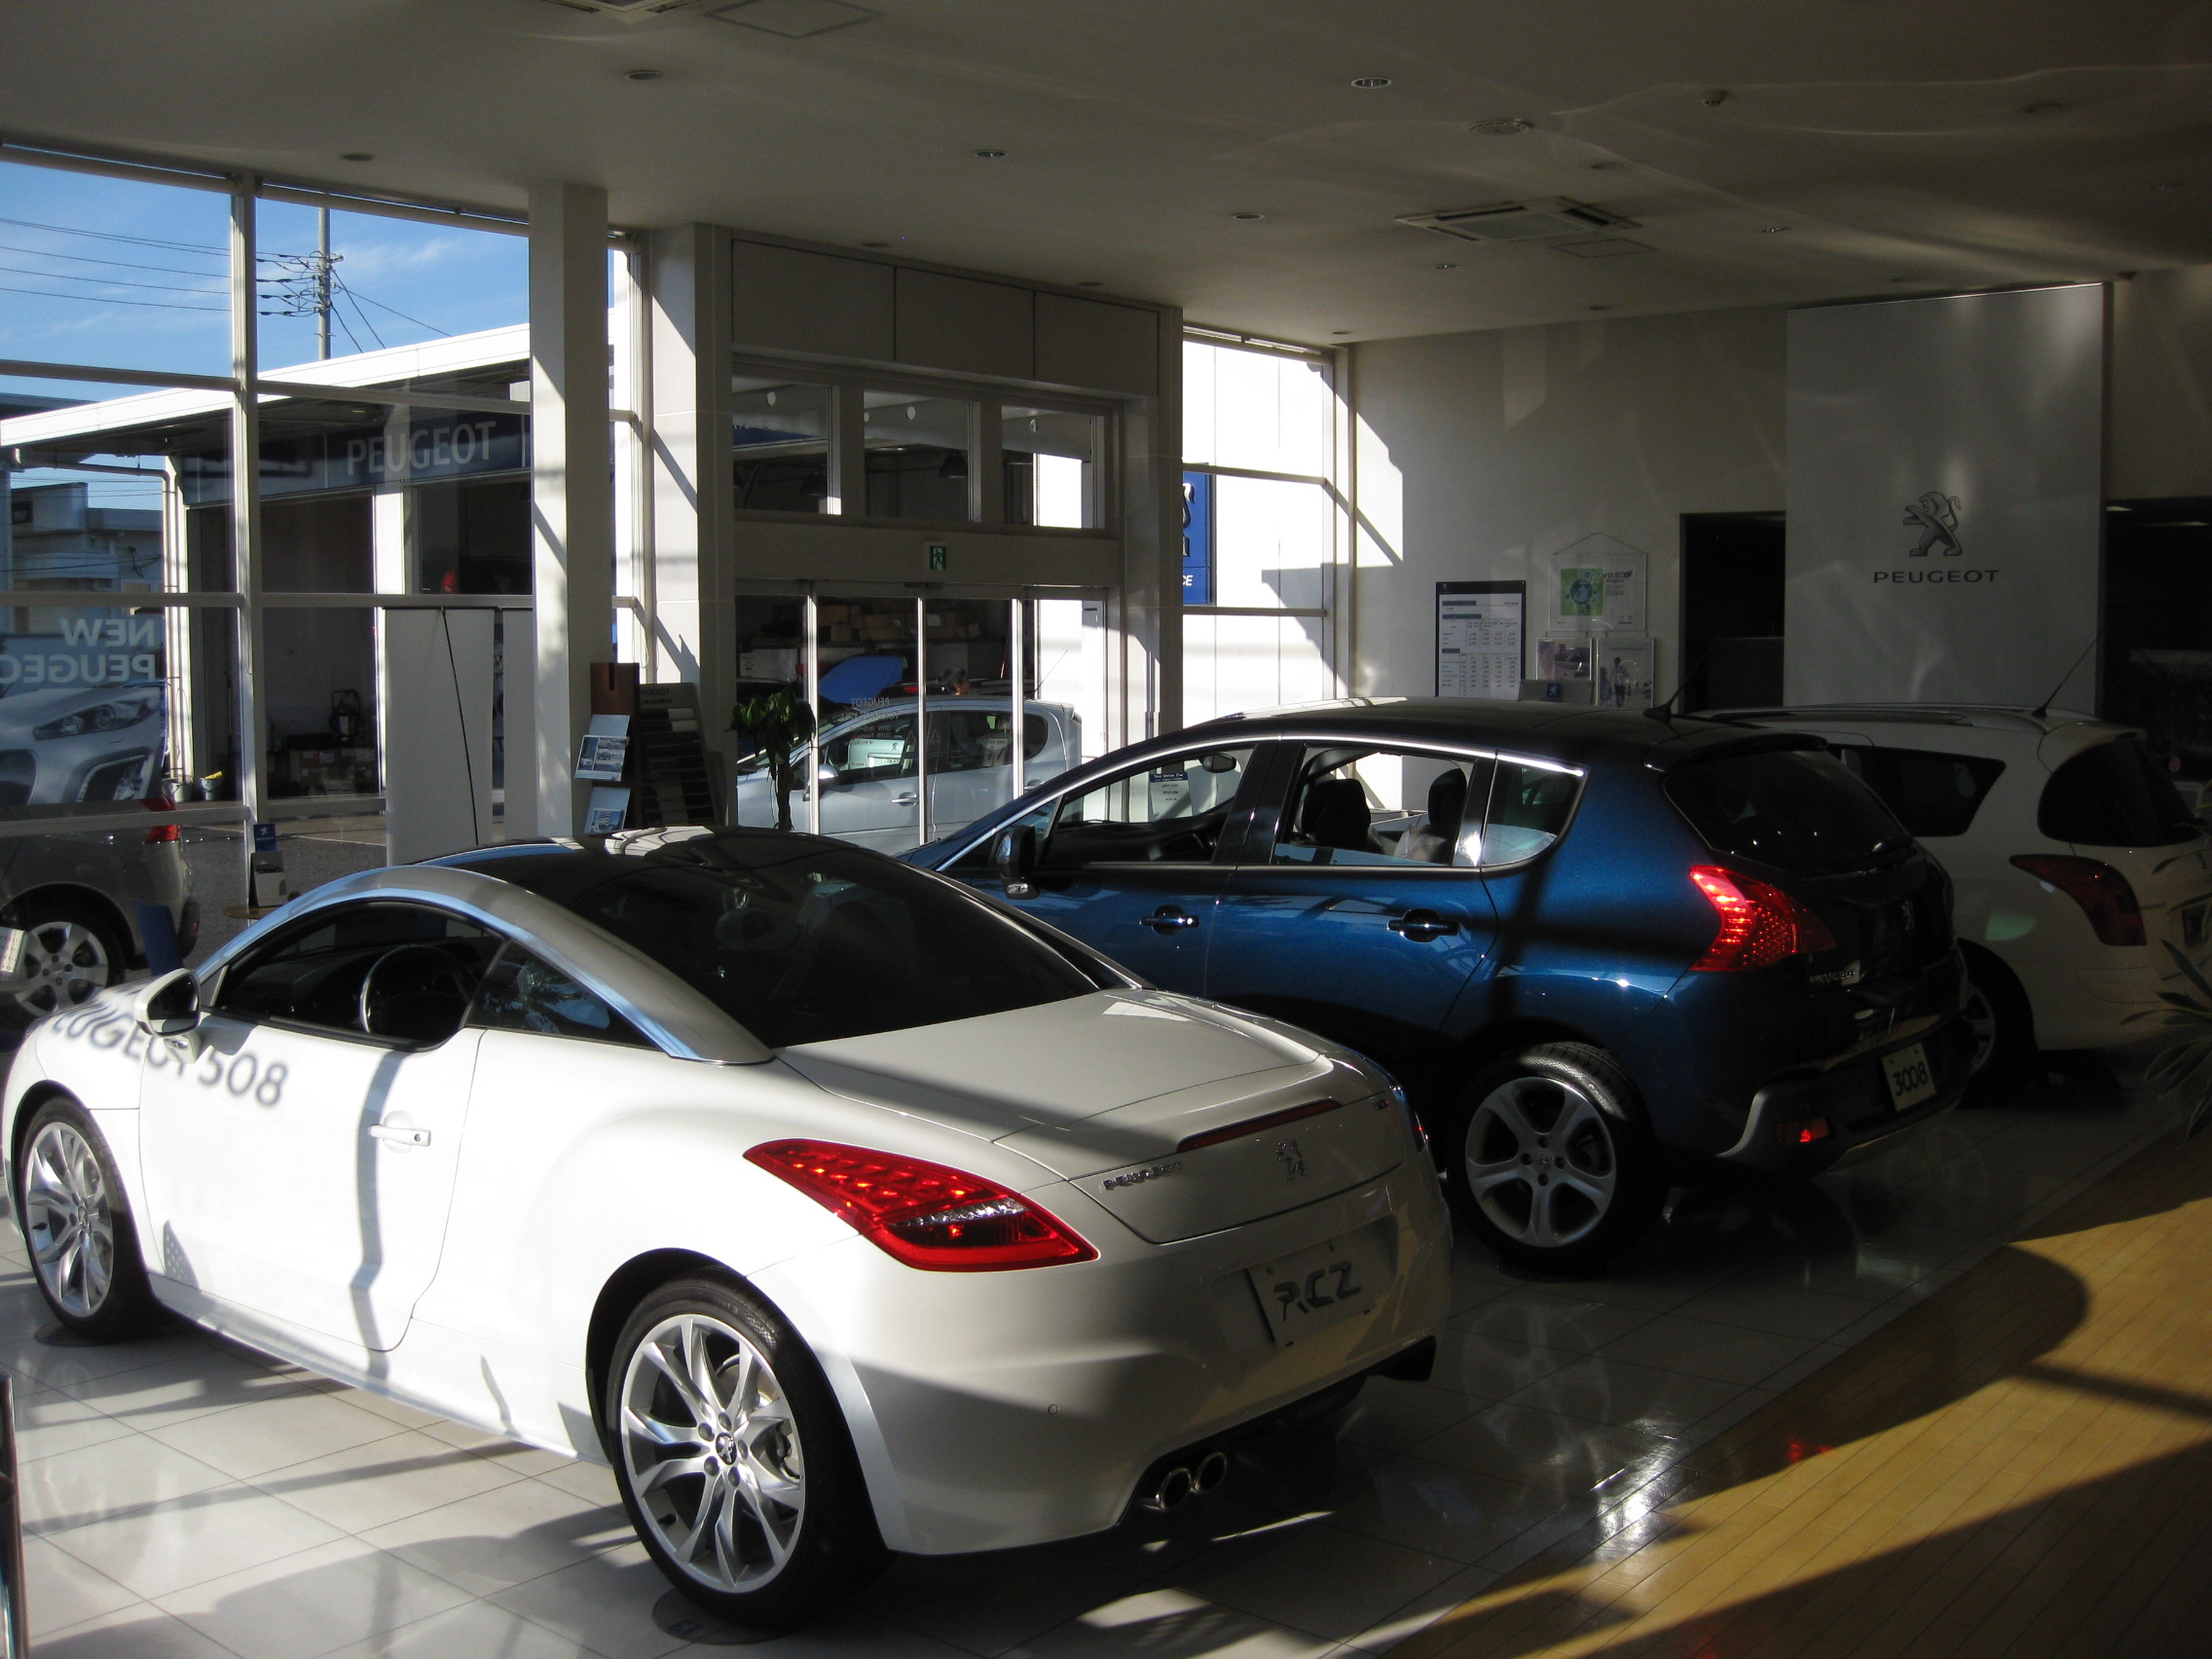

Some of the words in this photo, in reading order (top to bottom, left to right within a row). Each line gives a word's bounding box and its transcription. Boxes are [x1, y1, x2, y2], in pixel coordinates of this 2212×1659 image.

[348, 421, 497, 476] PEUGEOT
[1873, 570, 2000, 584] PEUGEOT
[198, 1048, 288, 1107] 508
[1892, 1060, 1929, 1097] 3008
[1273, 1260, 1362, 1322] RCZ
